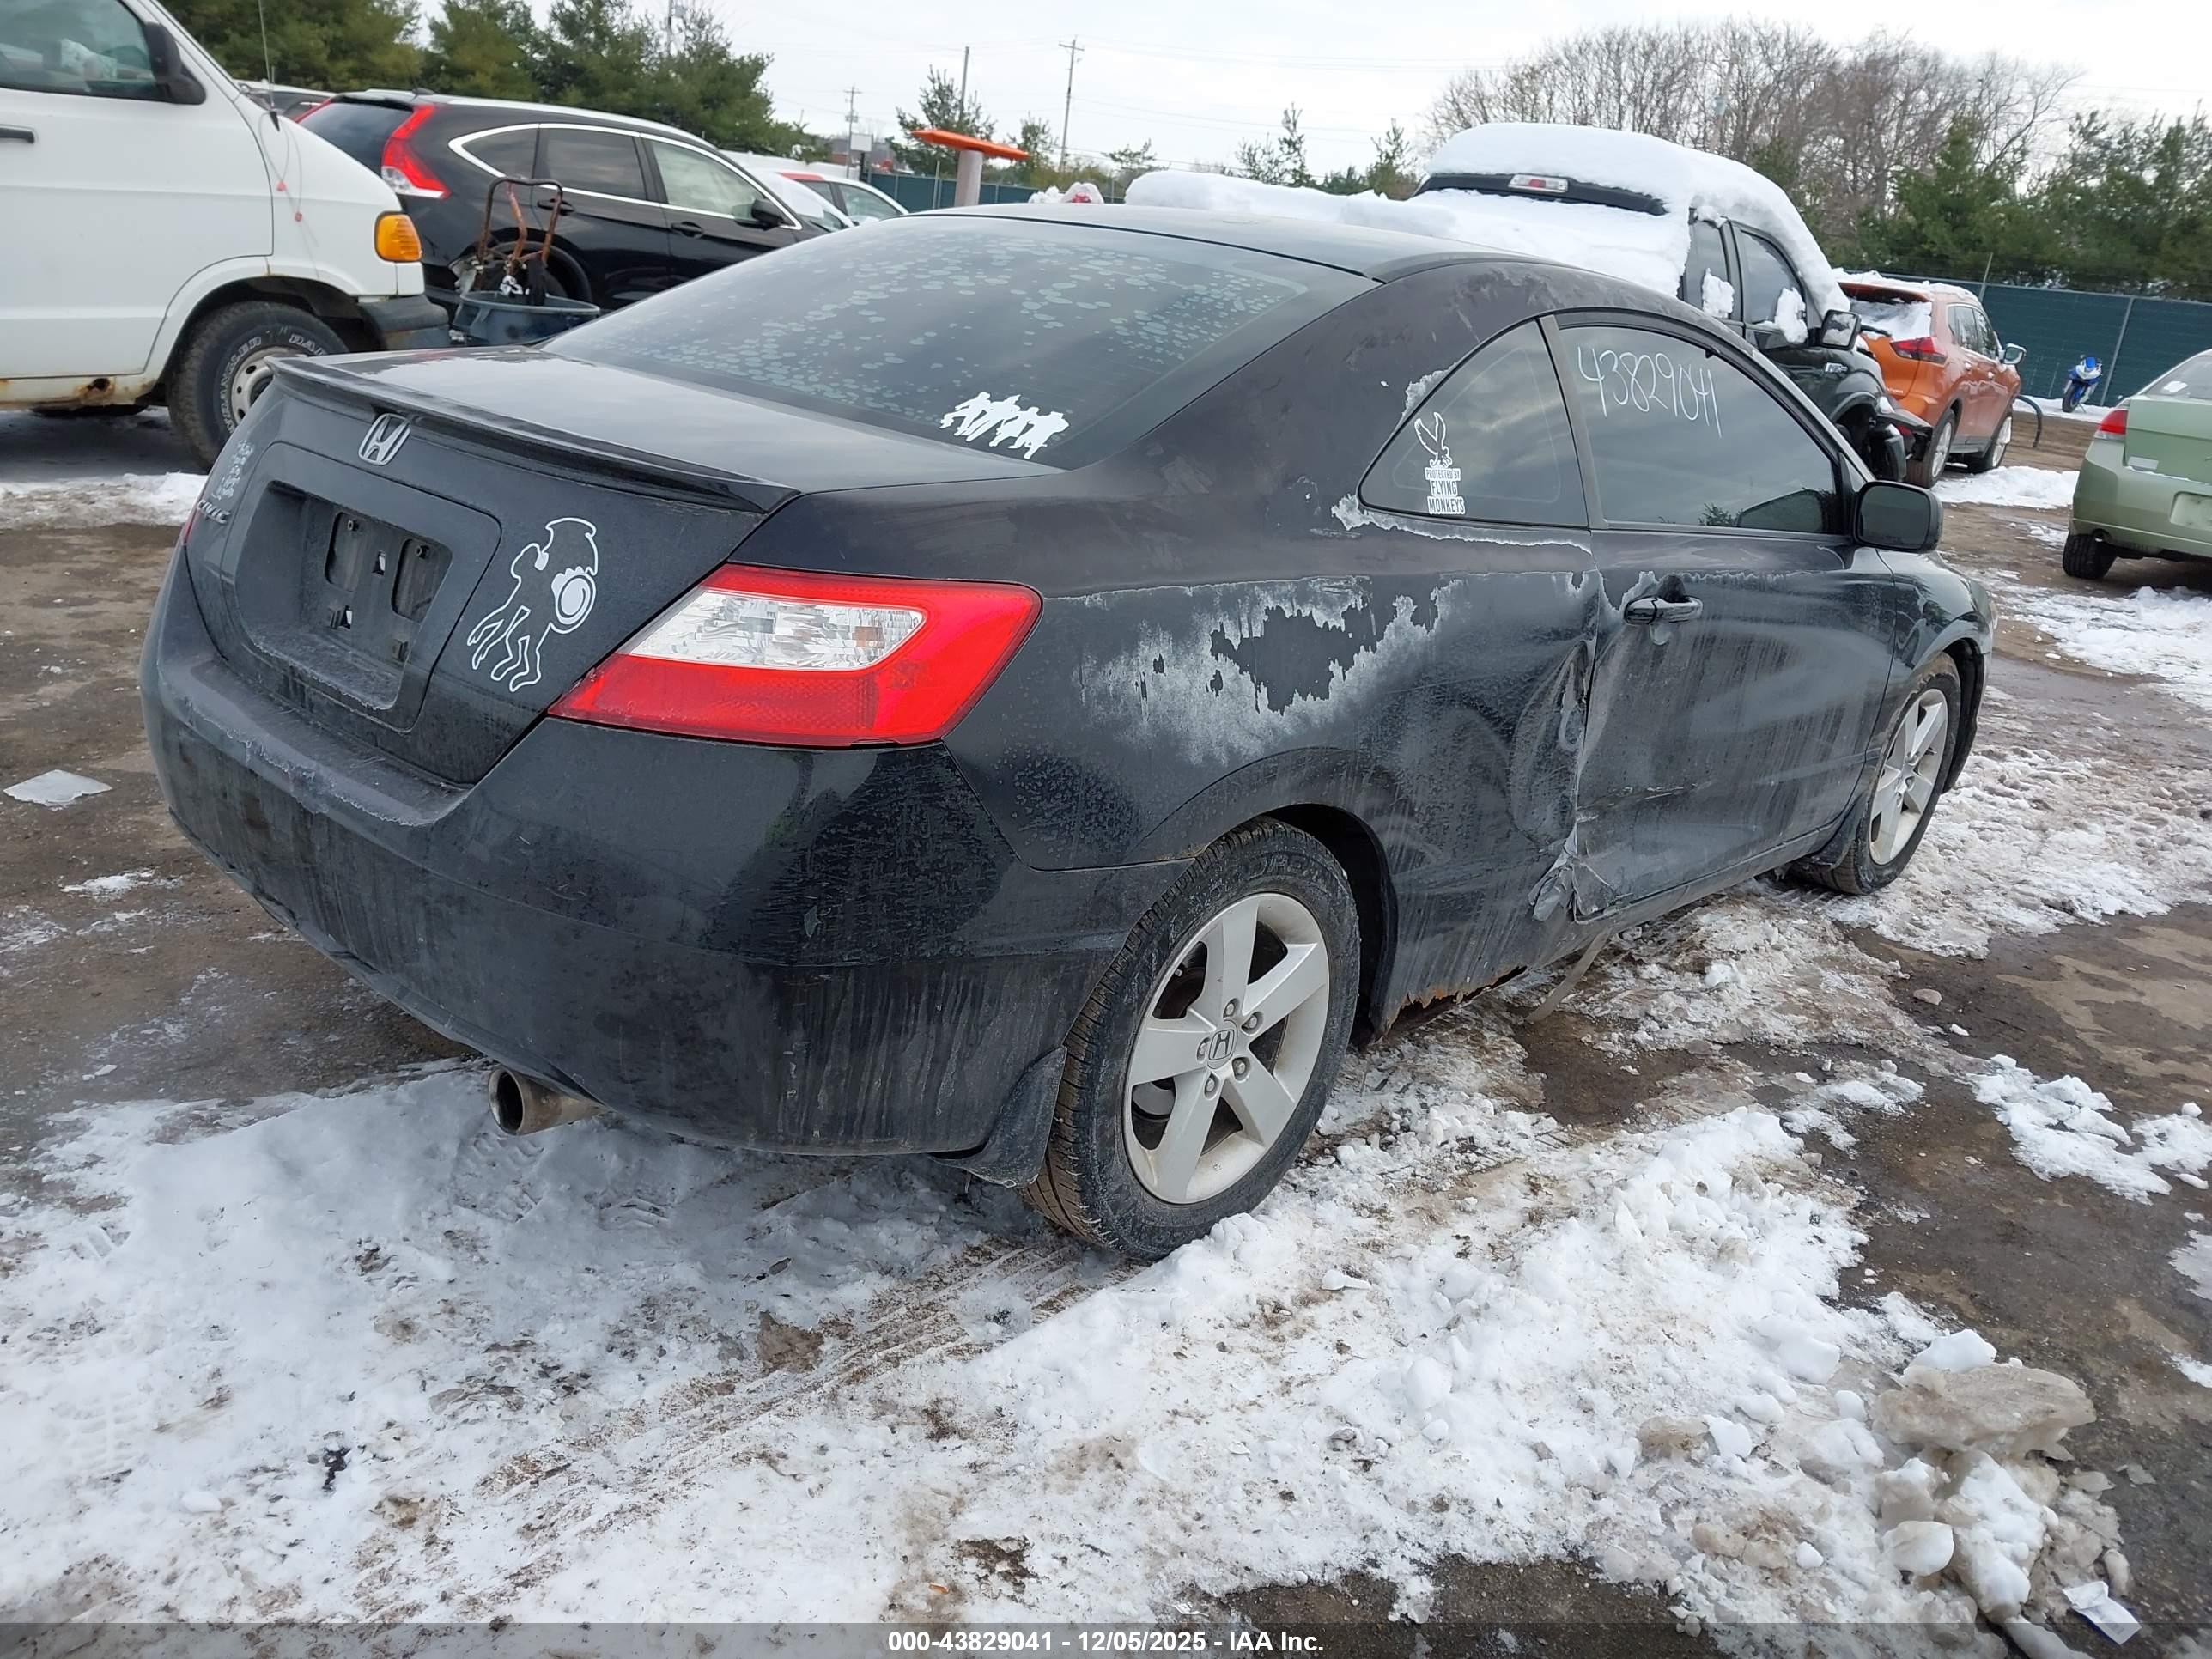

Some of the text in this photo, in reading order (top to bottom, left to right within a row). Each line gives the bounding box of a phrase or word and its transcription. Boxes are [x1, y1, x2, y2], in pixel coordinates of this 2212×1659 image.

[1577, 345, 1722, 439] 43829041
[1425, 469, 1460, 479] PROTECTED BY
[1431, 480, 1457, 495] FLYING
[197, 499, 230, 525] CIVIC
[1428, 498, 1465, 514] MONKEYS
